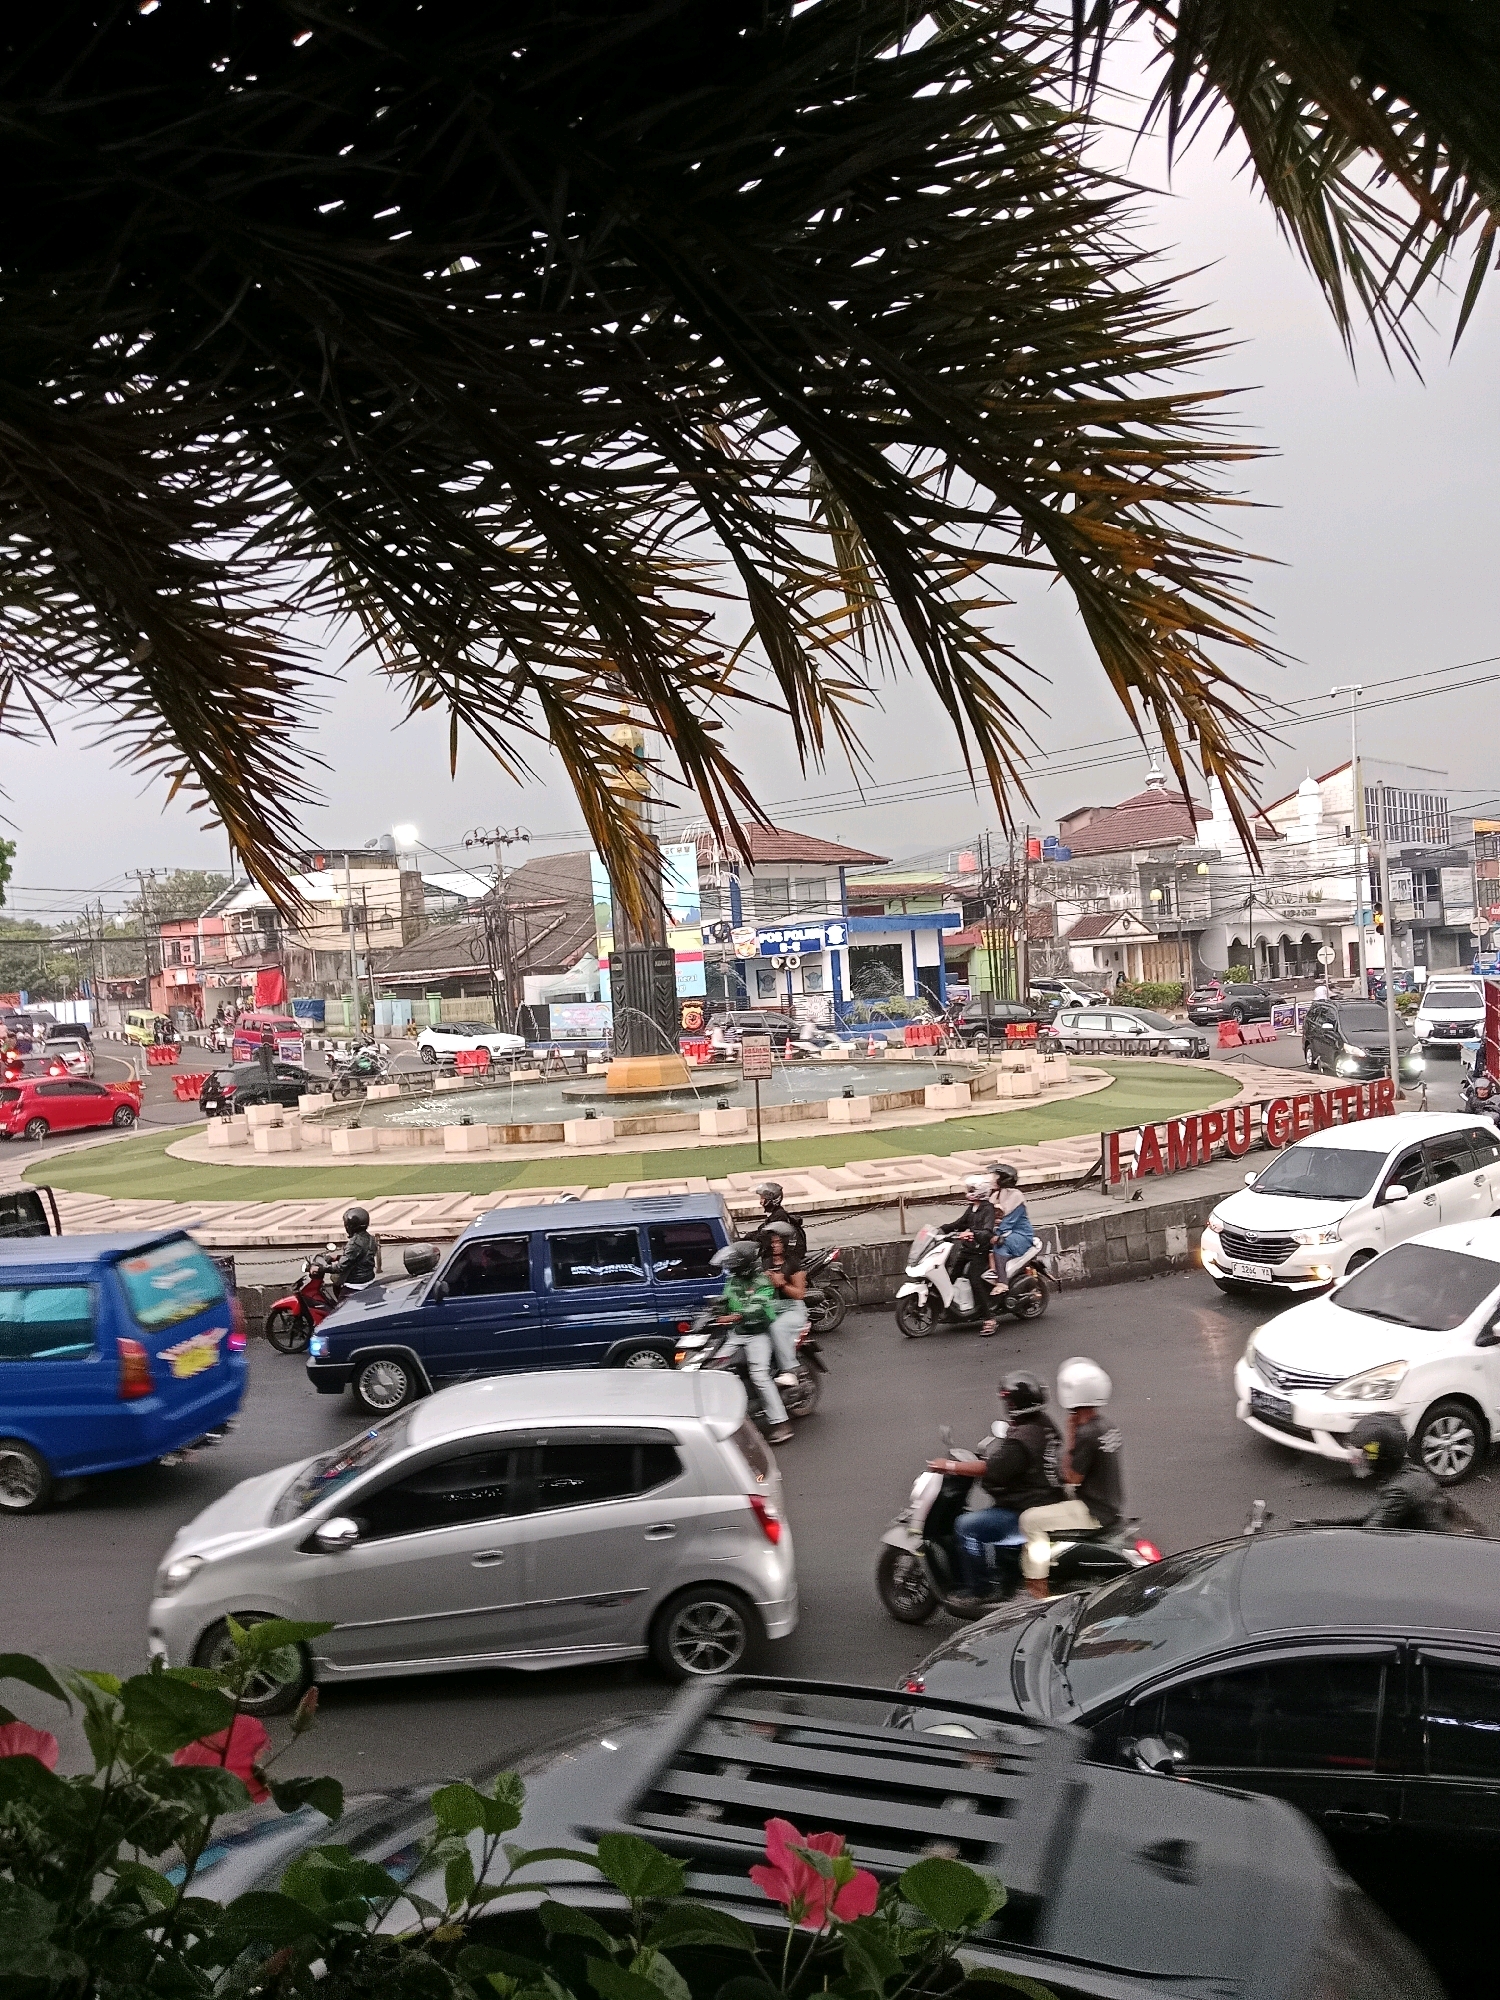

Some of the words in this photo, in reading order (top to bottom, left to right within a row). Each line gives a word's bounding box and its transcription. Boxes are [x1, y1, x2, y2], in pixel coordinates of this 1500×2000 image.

[758, 932, 784, 944] POS
[1109, 1107, 1250, 1184] LAMPU
[1264, 1079, 1396, 1148] GENTUR
